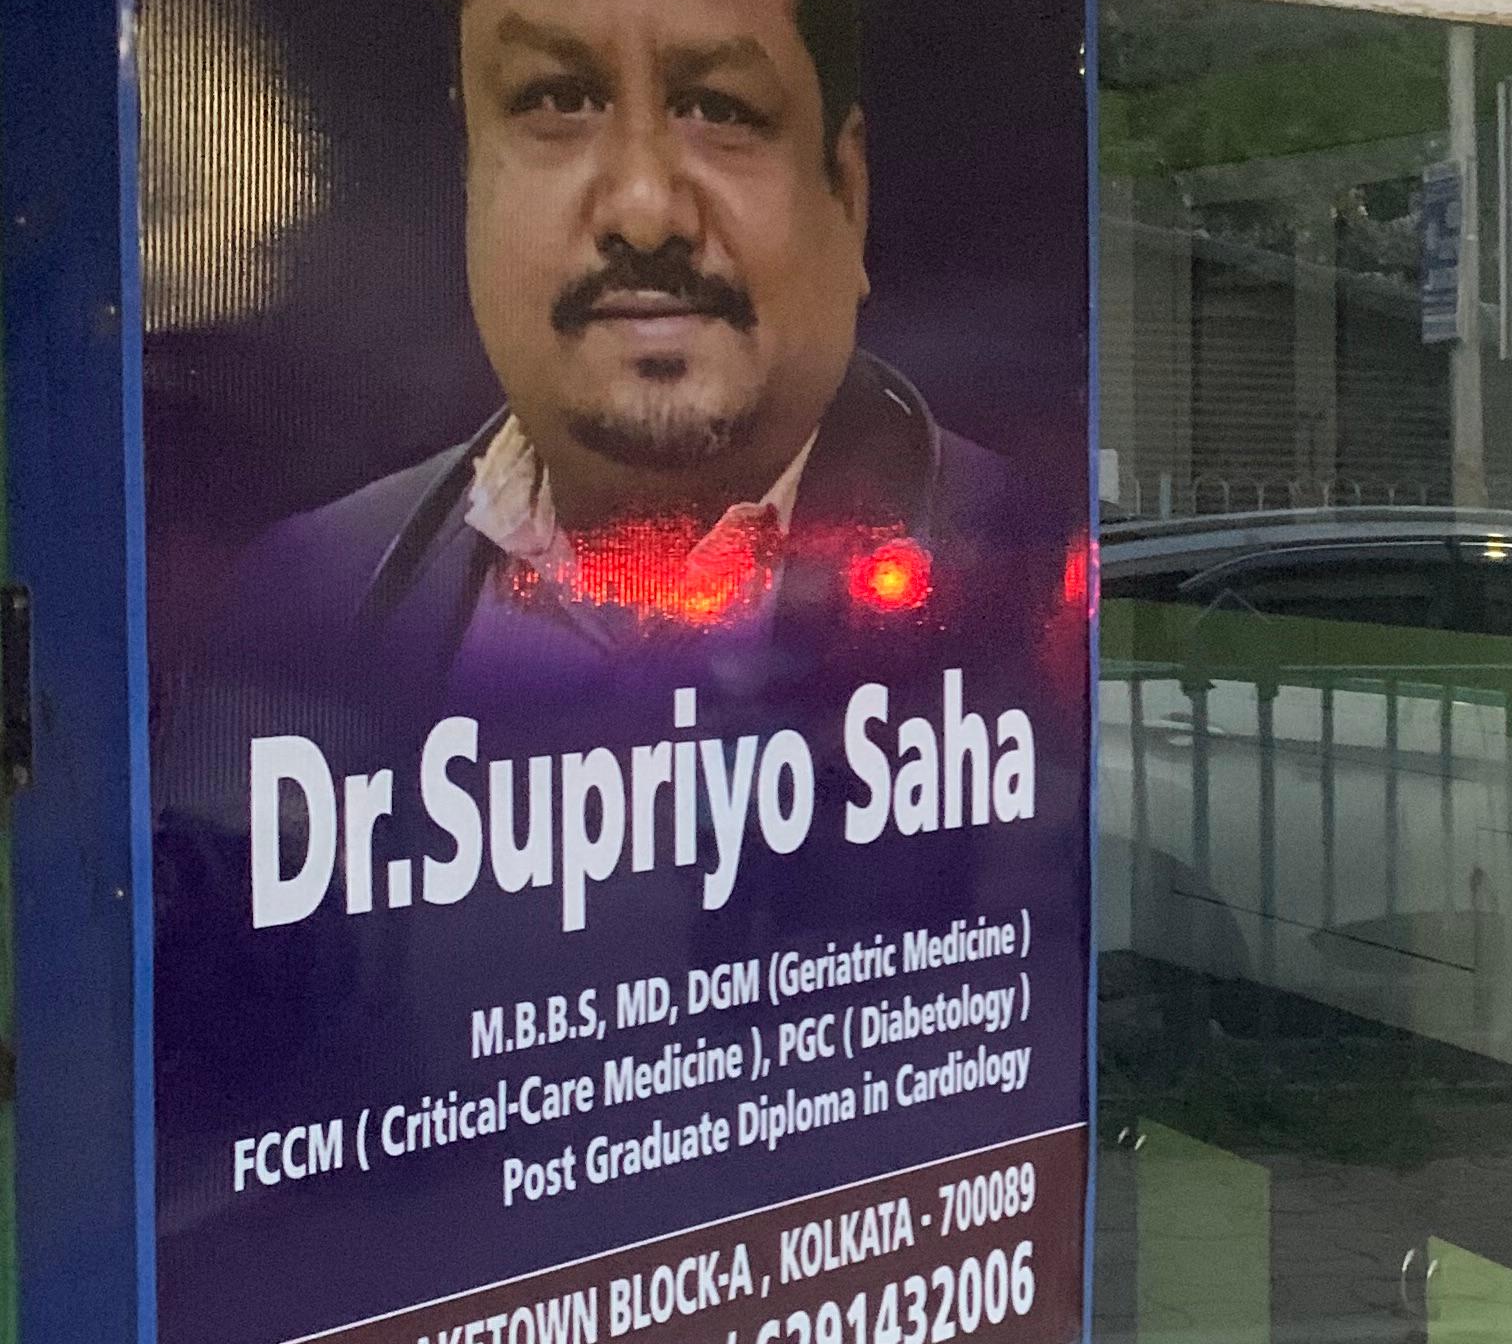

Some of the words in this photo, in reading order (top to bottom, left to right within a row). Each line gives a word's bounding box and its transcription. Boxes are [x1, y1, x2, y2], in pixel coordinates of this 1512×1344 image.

[844, 668, 1036, 844] Saha
[472, 988, 607, 1059] M.B.B.S,
[616, 976, 679, 1029] MD,
[687, 958, 760, 1015] DGM
[768, 934, 897, 1006] (Geriatric
[902, 915, 1016, 973] Medicine
[234, 1118, 343, 1193] FCCM
[381, 1075, 595, 1157] Critical-Care
[603, 1043, 744, 1106] Medicine
[779, 1013, 835, 1067] PGC
[861, 985, 1016, 1049] Diabetology
[503, 1145, 577, 1207] Post
[585, 1112, 730, 1184] Graduate
[738, 1087, 856, 1151] Diploma
[863, 1072, 889, 1116] in
[895, 1046, 1032, 1107] Cardiology
[609, 1243, 754, 1338] BLOCK-A
[780, 1197, 915, 1285] KOLKATA
[938, 1161, 1036, 1237] 700089
